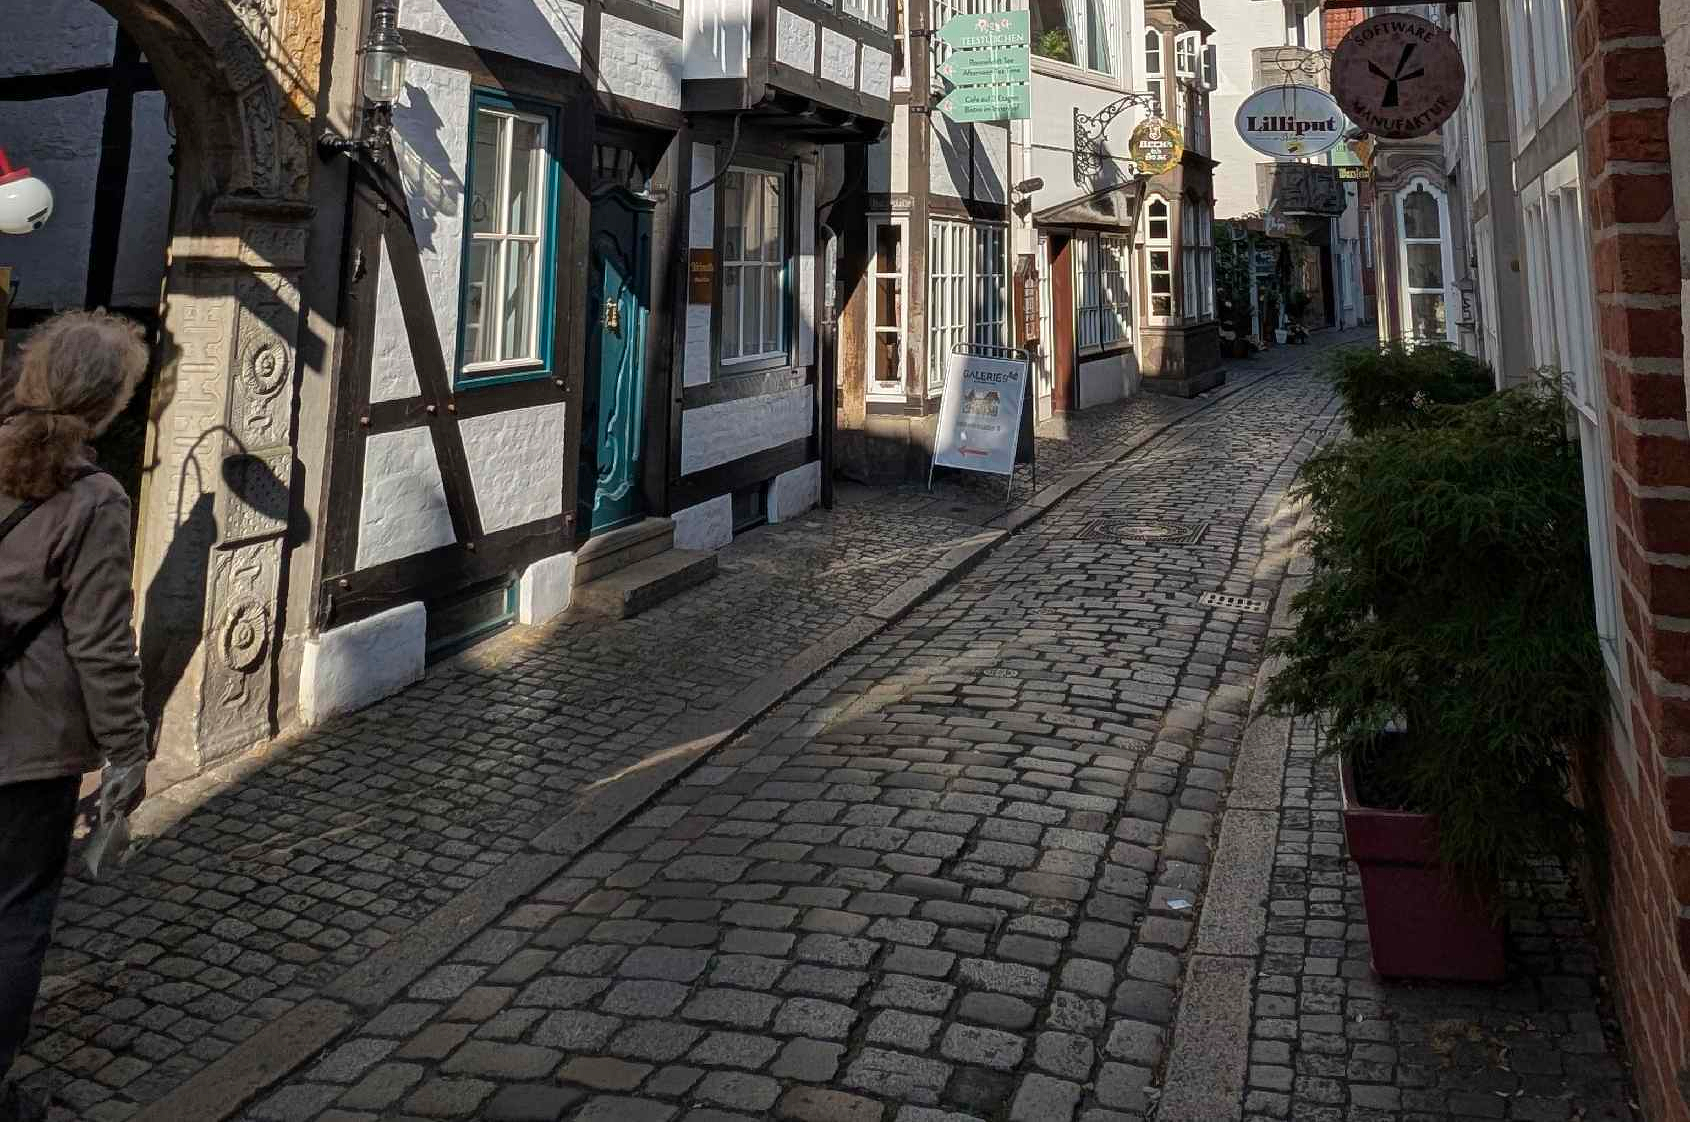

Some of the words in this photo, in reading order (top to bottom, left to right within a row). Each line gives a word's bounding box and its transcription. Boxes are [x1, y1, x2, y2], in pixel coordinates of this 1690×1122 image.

[1354, 21, 1434, 46] SOFTWARE
[1247, 116, 1337, 136] Lilliput
[1353, 97, 1449, 130] MANUFAKTUR
